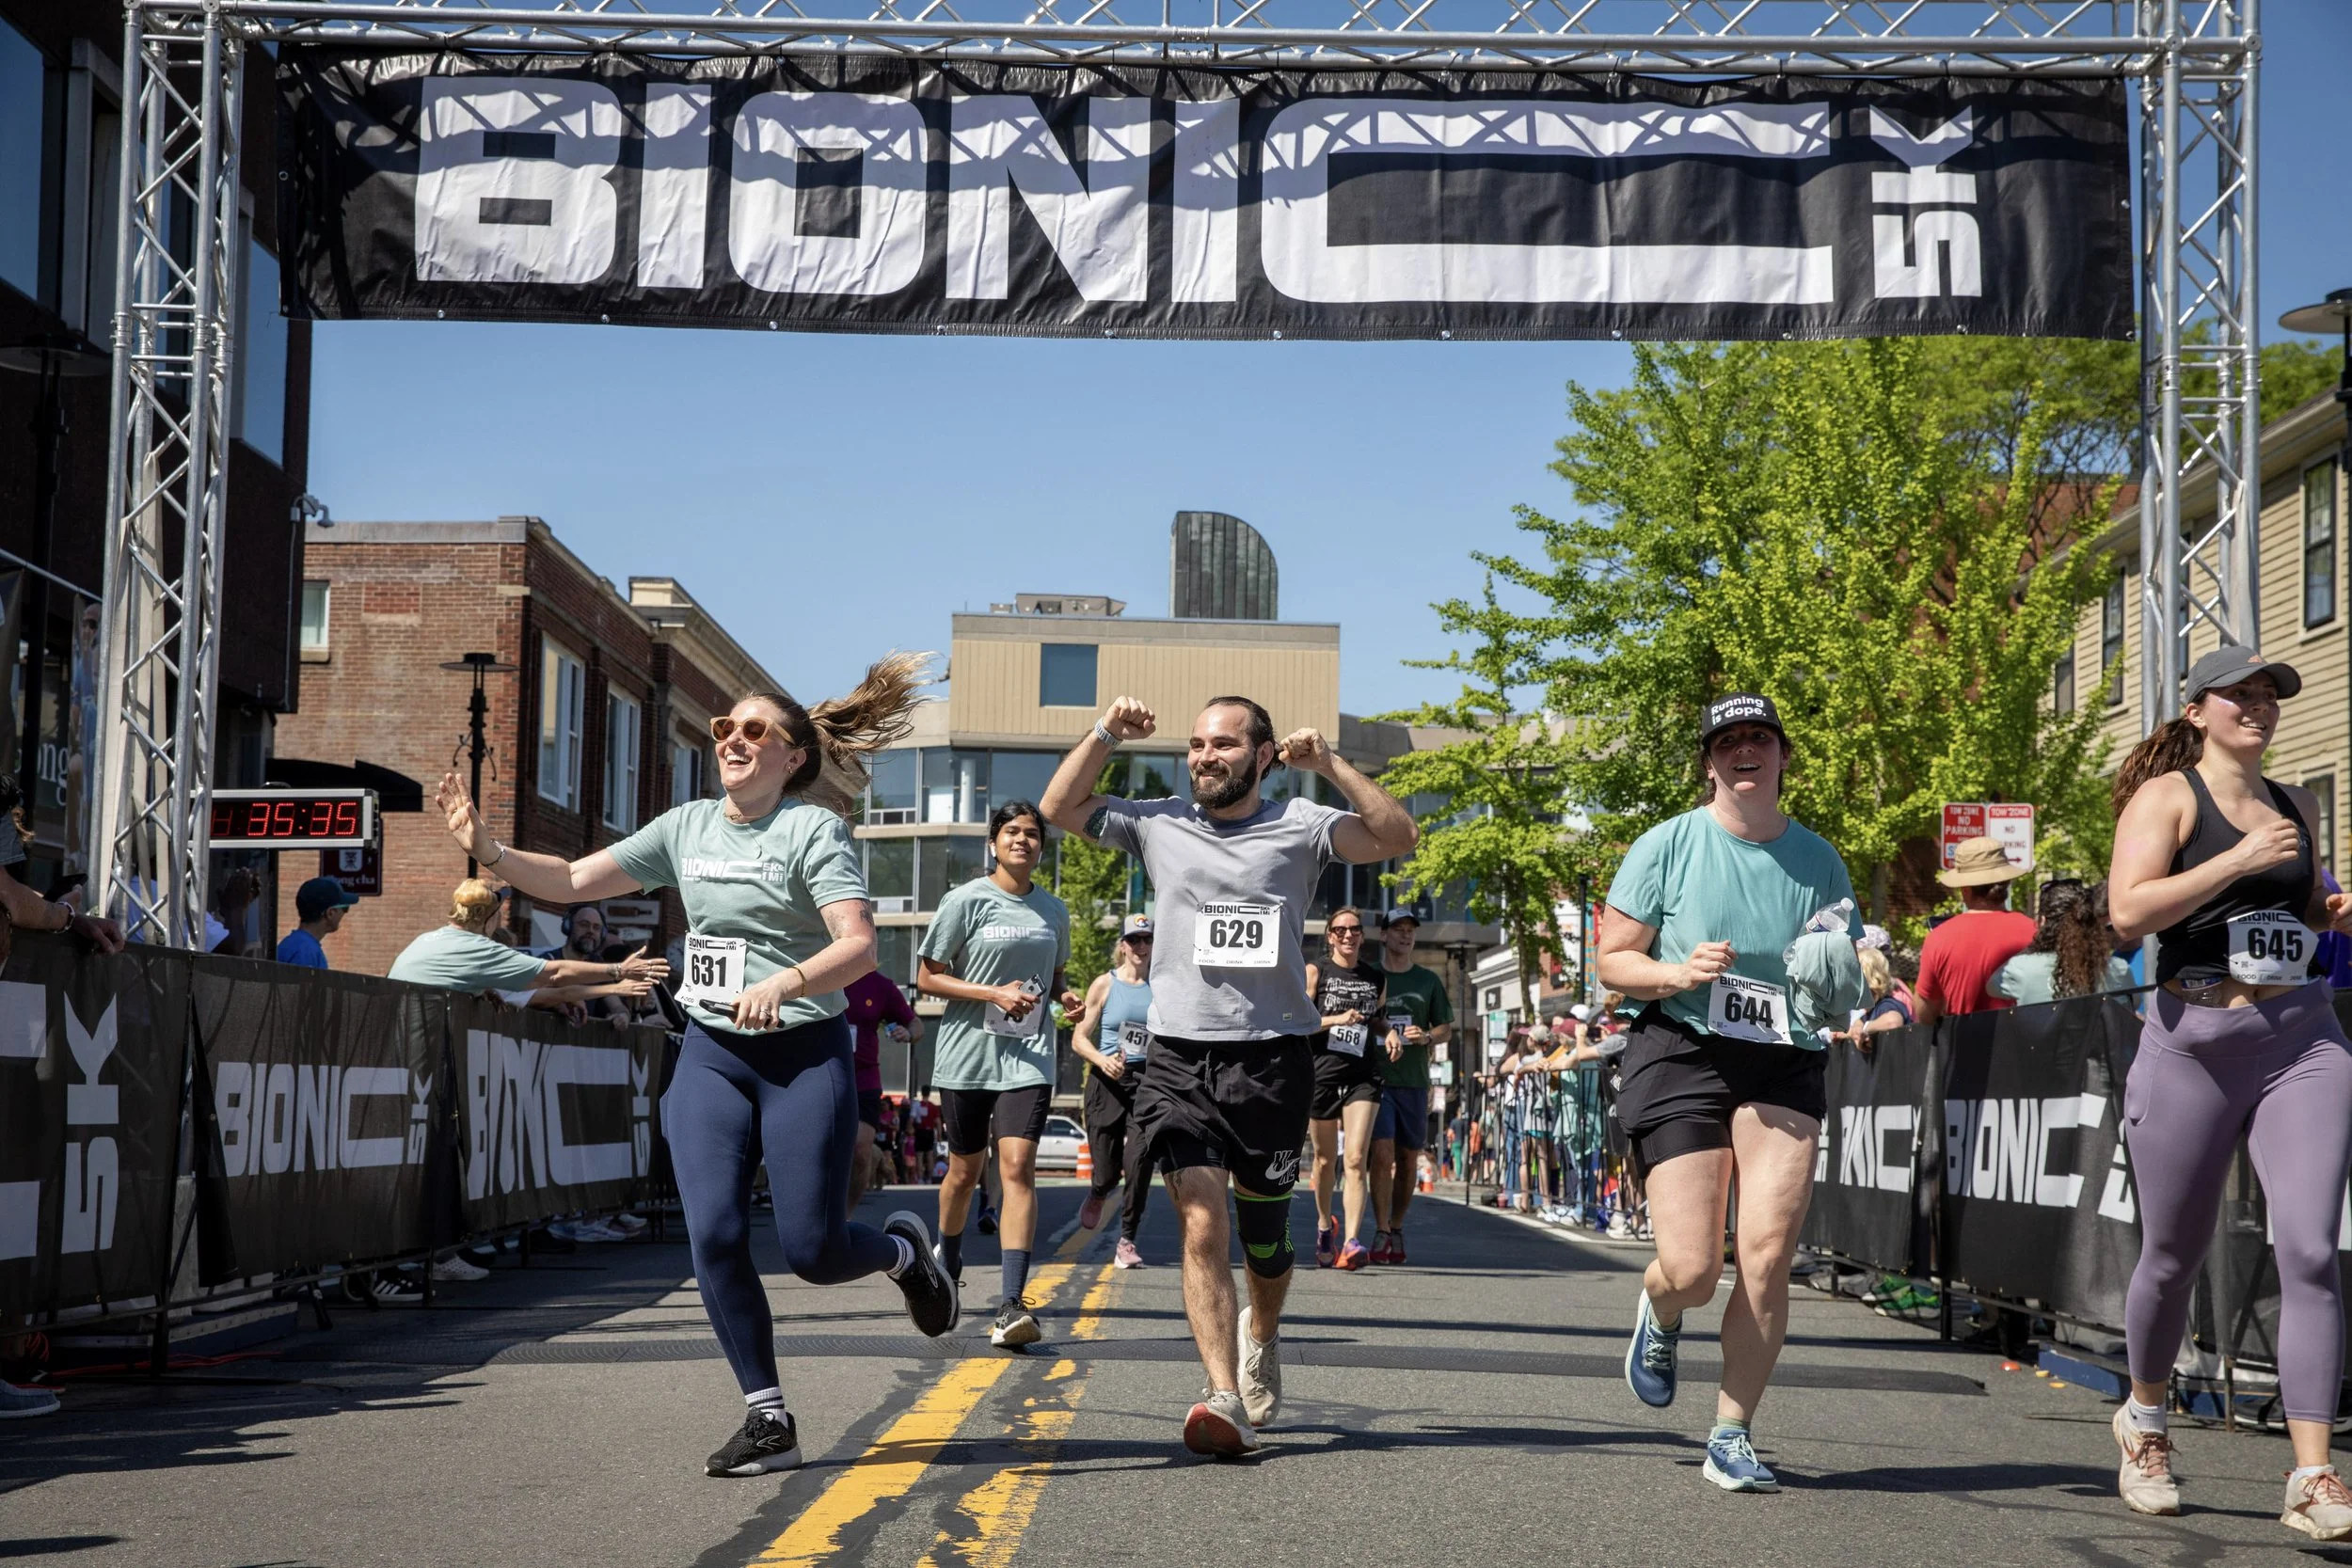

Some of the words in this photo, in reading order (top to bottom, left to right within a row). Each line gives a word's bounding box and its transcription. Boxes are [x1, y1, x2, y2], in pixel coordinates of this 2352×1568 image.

[415, 76, 1835, 305] BIONIC
[1869, 103, 1982, 299] 5K
[1711, 696, 1764, 715] Running
[1712, 715, 1722, 725] is
[1724, 706, 1767, 718] dope.
[247, 802, 357, 836] 35:35
[1945, 826, 1983, 835] PARKING
[1957, 816, 1971, 825] NO
[682, 858, 763, 879] BIONIC
[1204, 905, 1261, 915] BIONIC
[1210, 919, 1263, 949] 629
[2248, 927, 2303, 962] 645
[691, 954, 727, 988] 631
[1720, 975, 1769, 995] BIONIC
[1724, 992, 1774, 1029] 644
[1125, 1030, 1149, 1046] 451
[1336, 1028, 1360, 1045] 568
[61, 990, 119, 1255] 5K
[215, 1061, 409, 1177] BIONIC
[407, 1071, 433, 1164] 5K
[1944, 1092, 2106, 1208] BIONIC
